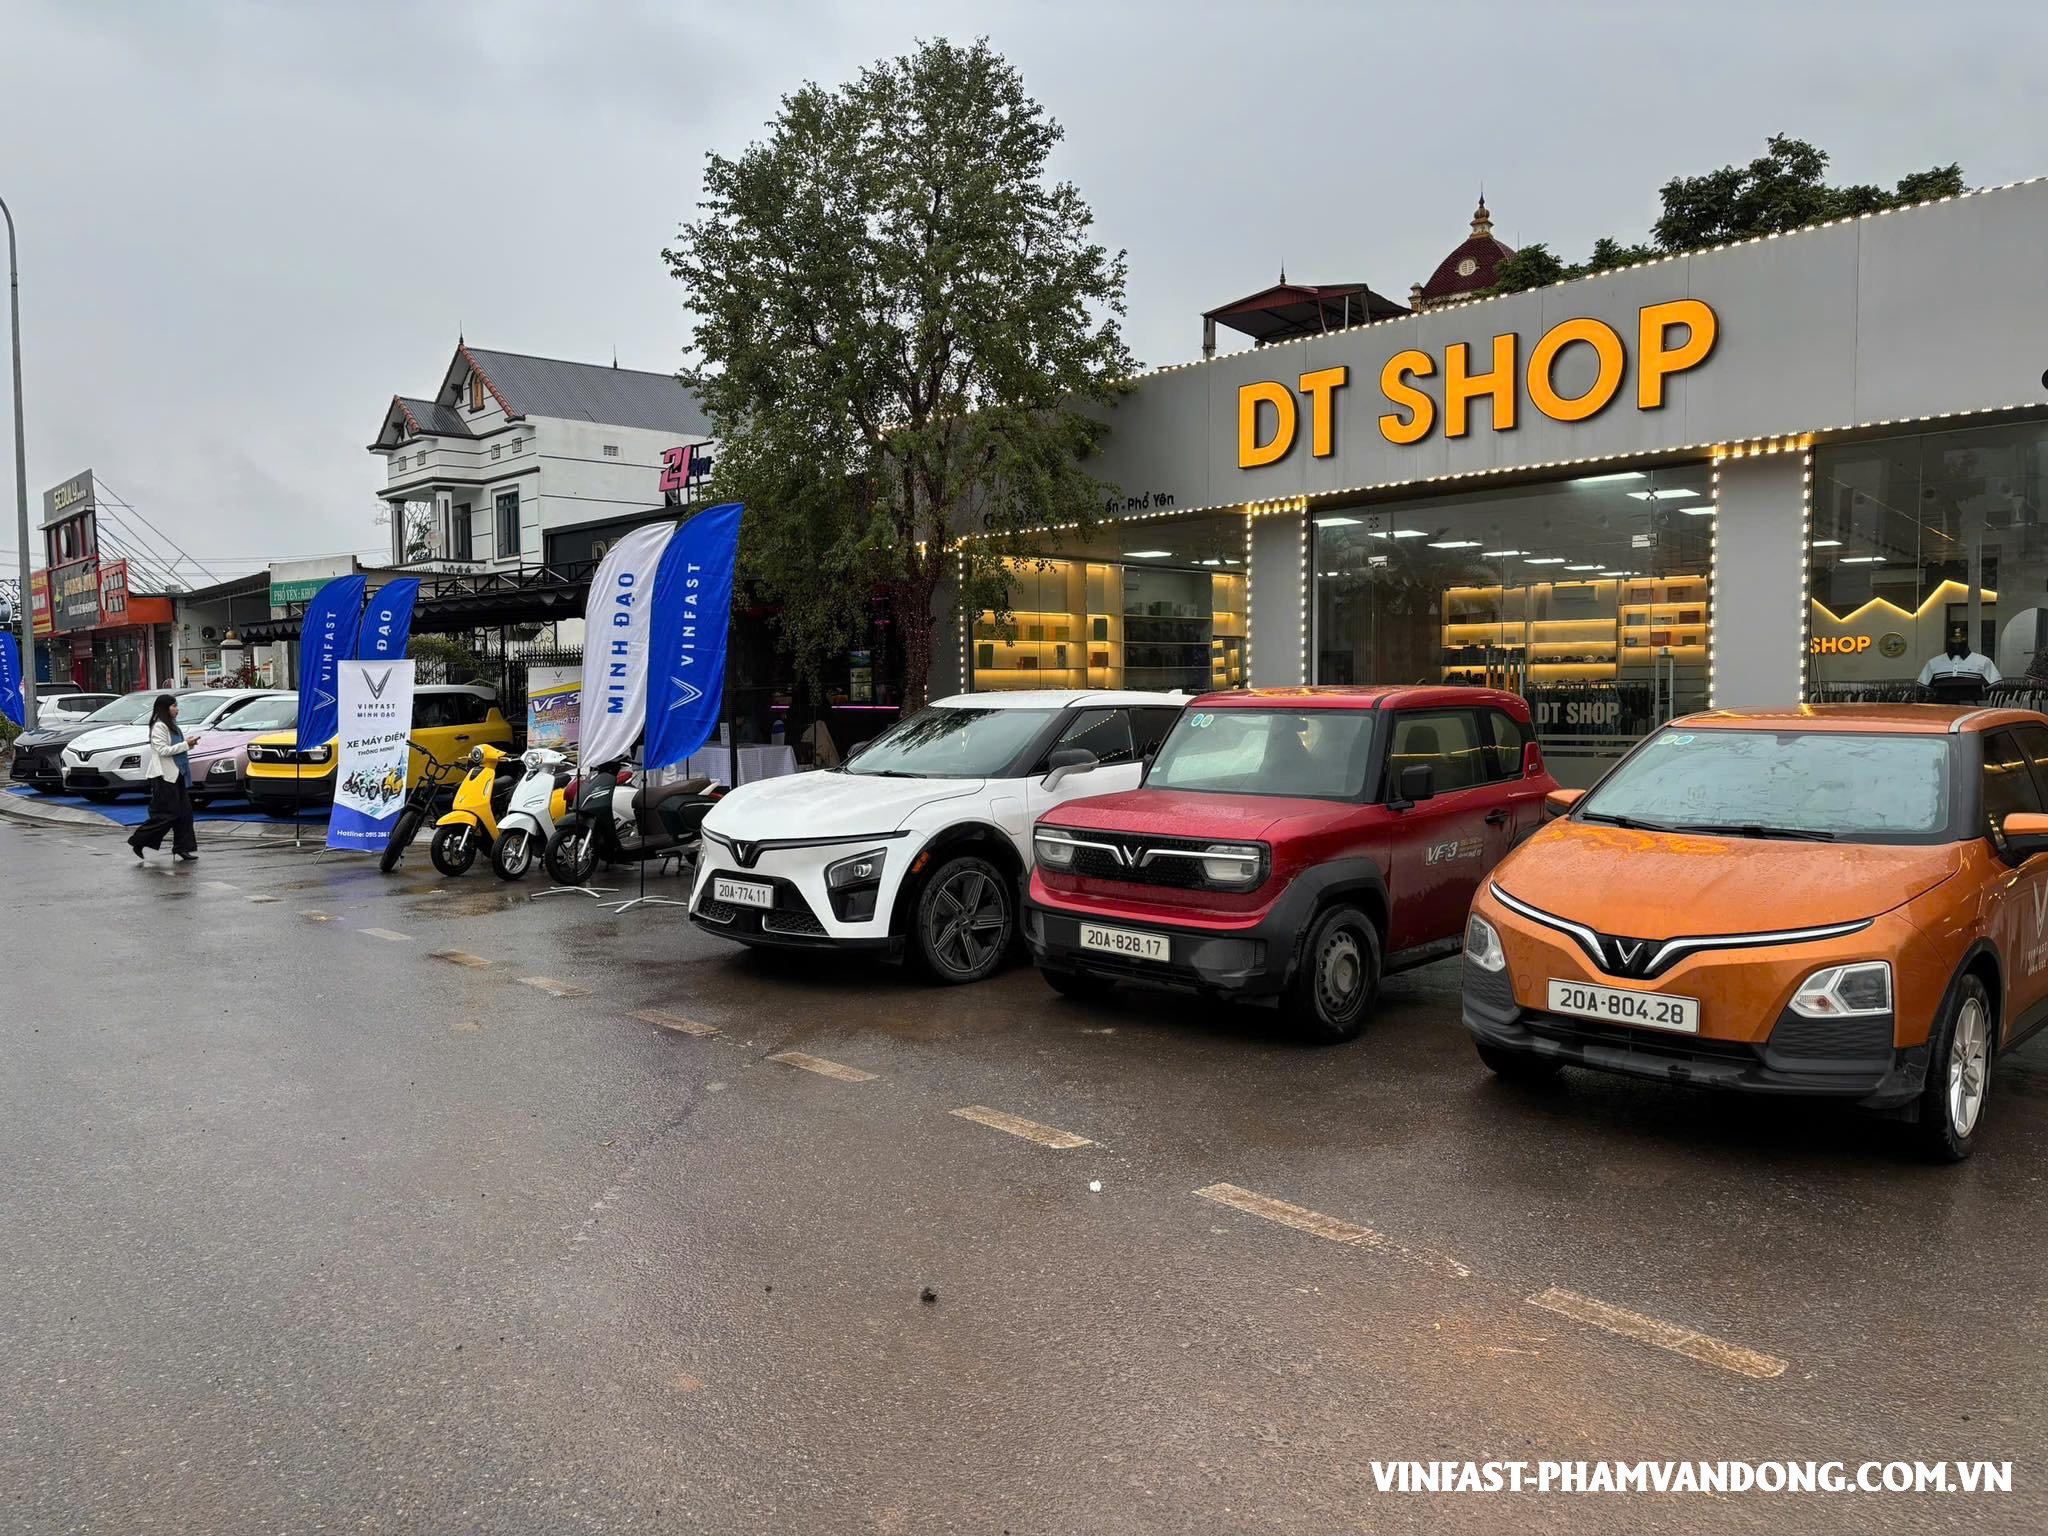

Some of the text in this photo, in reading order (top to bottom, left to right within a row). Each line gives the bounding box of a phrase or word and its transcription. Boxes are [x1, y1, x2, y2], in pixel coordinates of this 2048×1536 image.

[1238, 298, 1719, 469] DT SHOP
[1127, 491, 1150, 511] Phổ
[1153, 492, 1175, 508] Yên
[680, 562, 701, 667] VINFAST
[376, 610, 392, 651] ĐẠO
[607, 572, 635, 715] MINH ĐẠO
[321, 611, 337, 681] VINFAST
[1810, 635, 1872, 654] SHOP
[532, 694, 566, 713] VF
[1537, 702, 1620, 724] DT SHOP
[346, 731, 406, 749] XE MÁY ĐIỆN
[719, 884, 766, 903] 20A-774.11
[1087, 929, 1161, 955] 20A-828.17
[1559, 987, 1684, 1025] 20A-804.28
